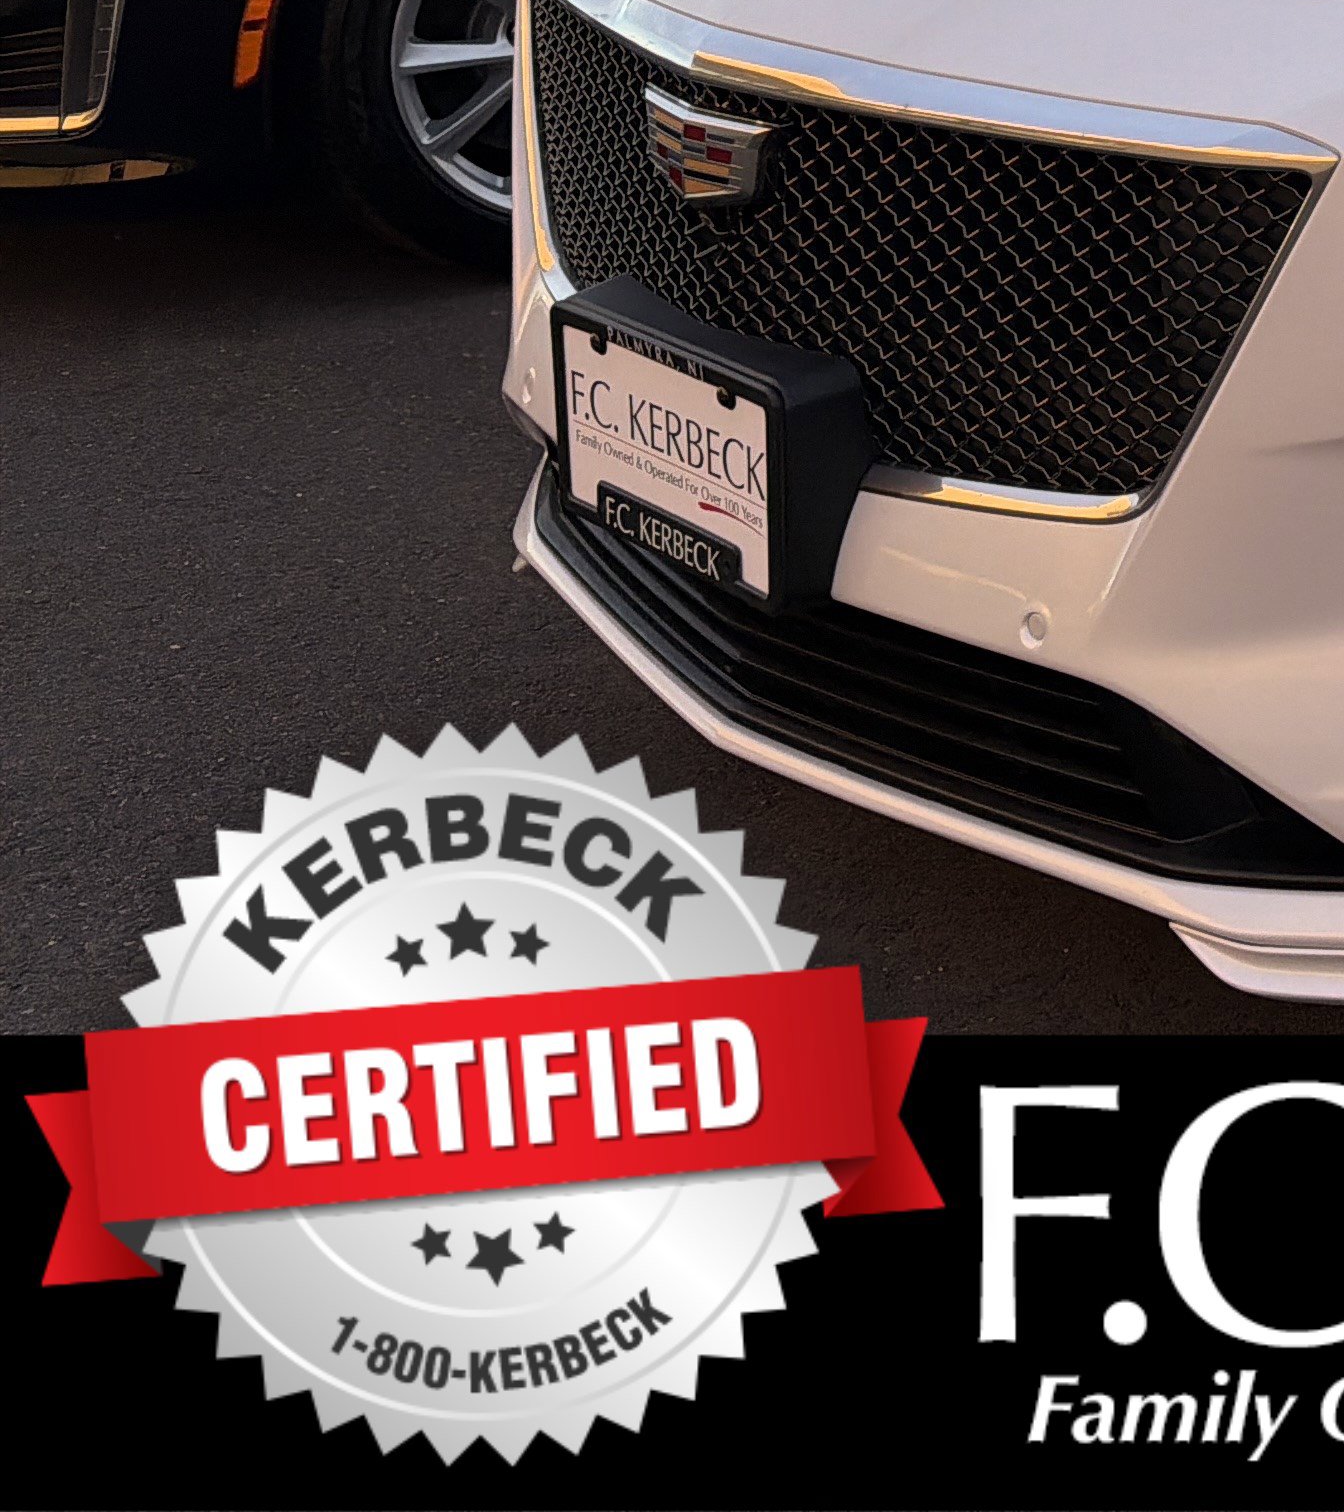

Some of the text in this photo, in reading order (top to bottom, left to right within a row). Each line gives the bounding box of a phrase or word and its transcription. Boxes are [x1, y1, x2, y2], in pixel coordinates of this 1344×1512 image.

[571, 370, 765, 501] F.C. KERBECK
[575, 429, 602, 454] Family
[603, 441, 634, 467] Owned
[636, 456, 643, 470] &
[644, 459, 684, 489] Operated
[685, 478, 699, 497] For
[701, 485, 722, 507] Over
[724, 496, 740, 516] 100
[605, 496, 720, 581] F.C. KERBECK
